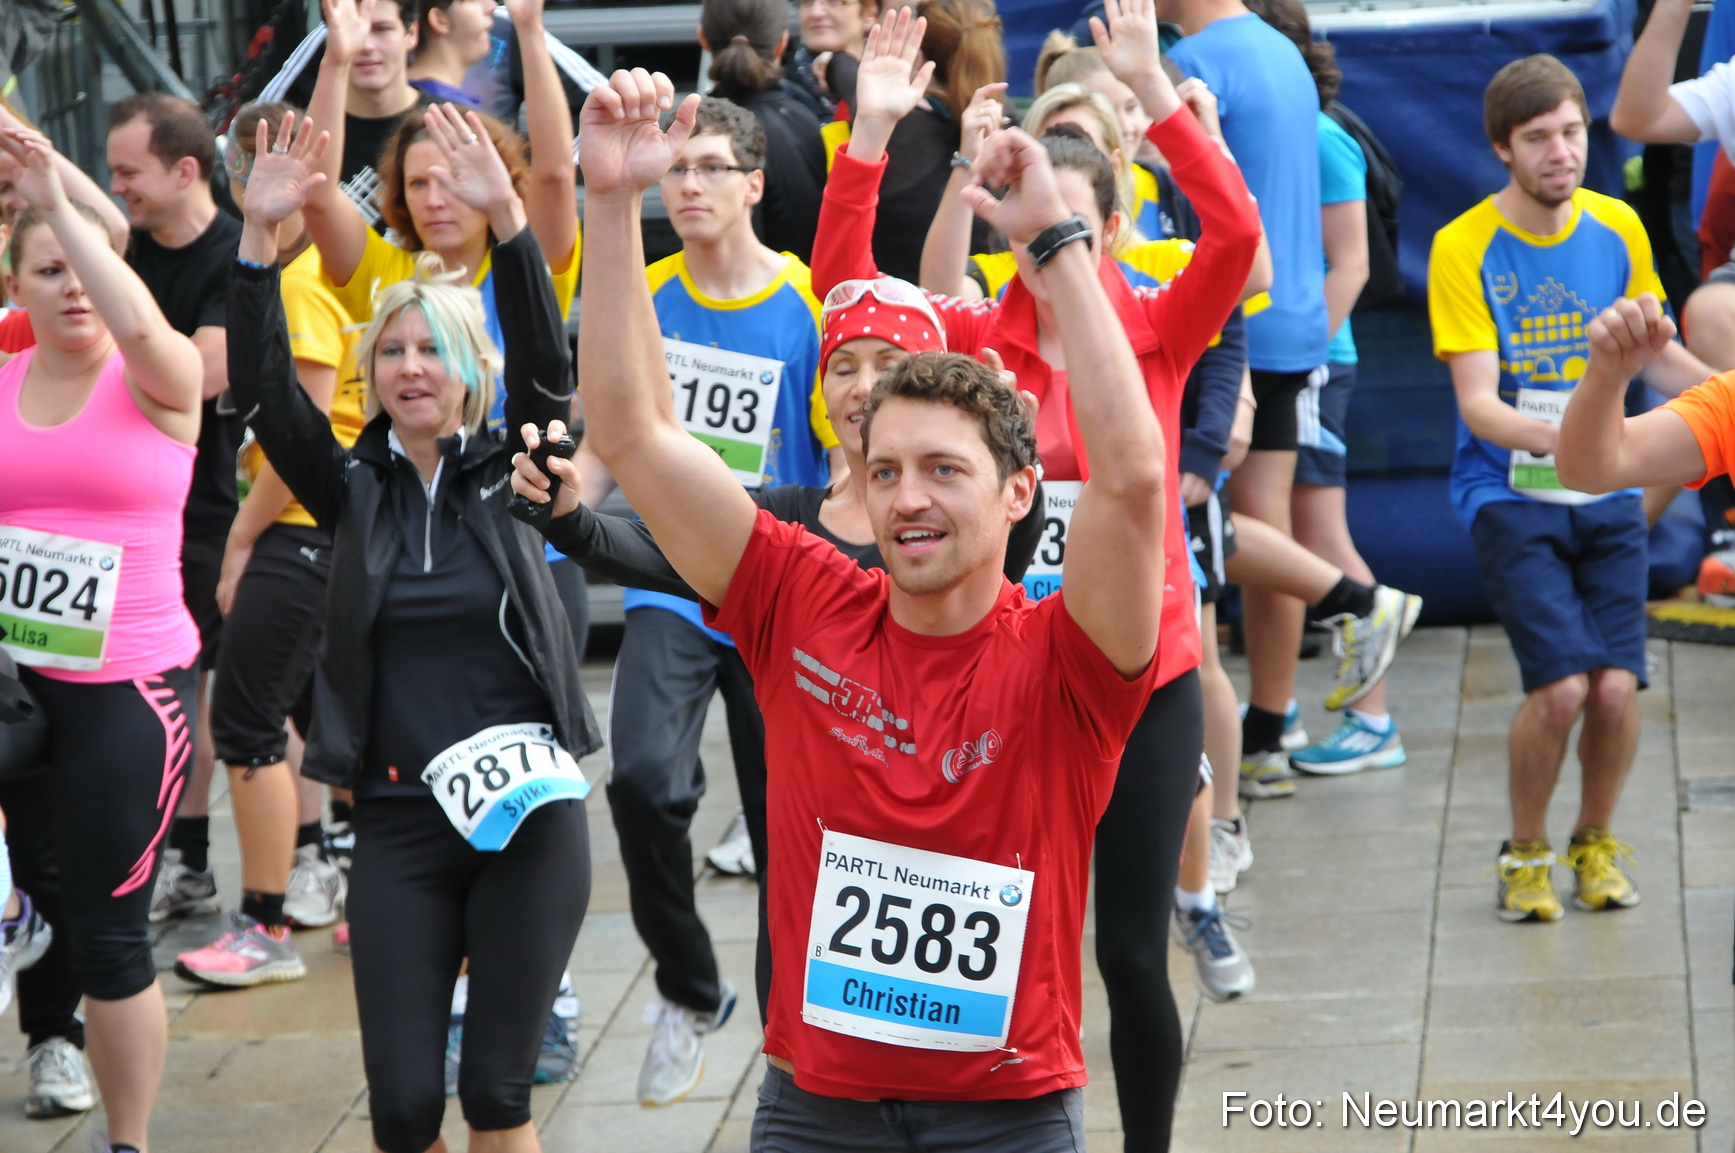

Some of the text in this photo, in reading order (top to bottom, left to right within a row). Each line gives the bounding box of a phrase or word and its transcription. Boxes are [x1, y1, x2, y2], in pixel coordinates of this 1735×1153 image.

[665, 352, 755, 380] RTL Neumarkt
[669, 373, 759, 434] 193
[1521, 400, 1562, 413] PARTL
[1048, 496, 1076, 508] Neu
[0, 537, 93, 566] RTL Neumarkt
[11, 622, 48, 647] Lisa
[447, 741, 561, 821] 2877
[502, 783, 553, 819] Sylke
[824, 851, 991, 900] PARTL Neumarkt
[828, 885, 1001, 981] 2583
[814, 945, 823, 958] B
[842, 978, 960, 1025] Christian
